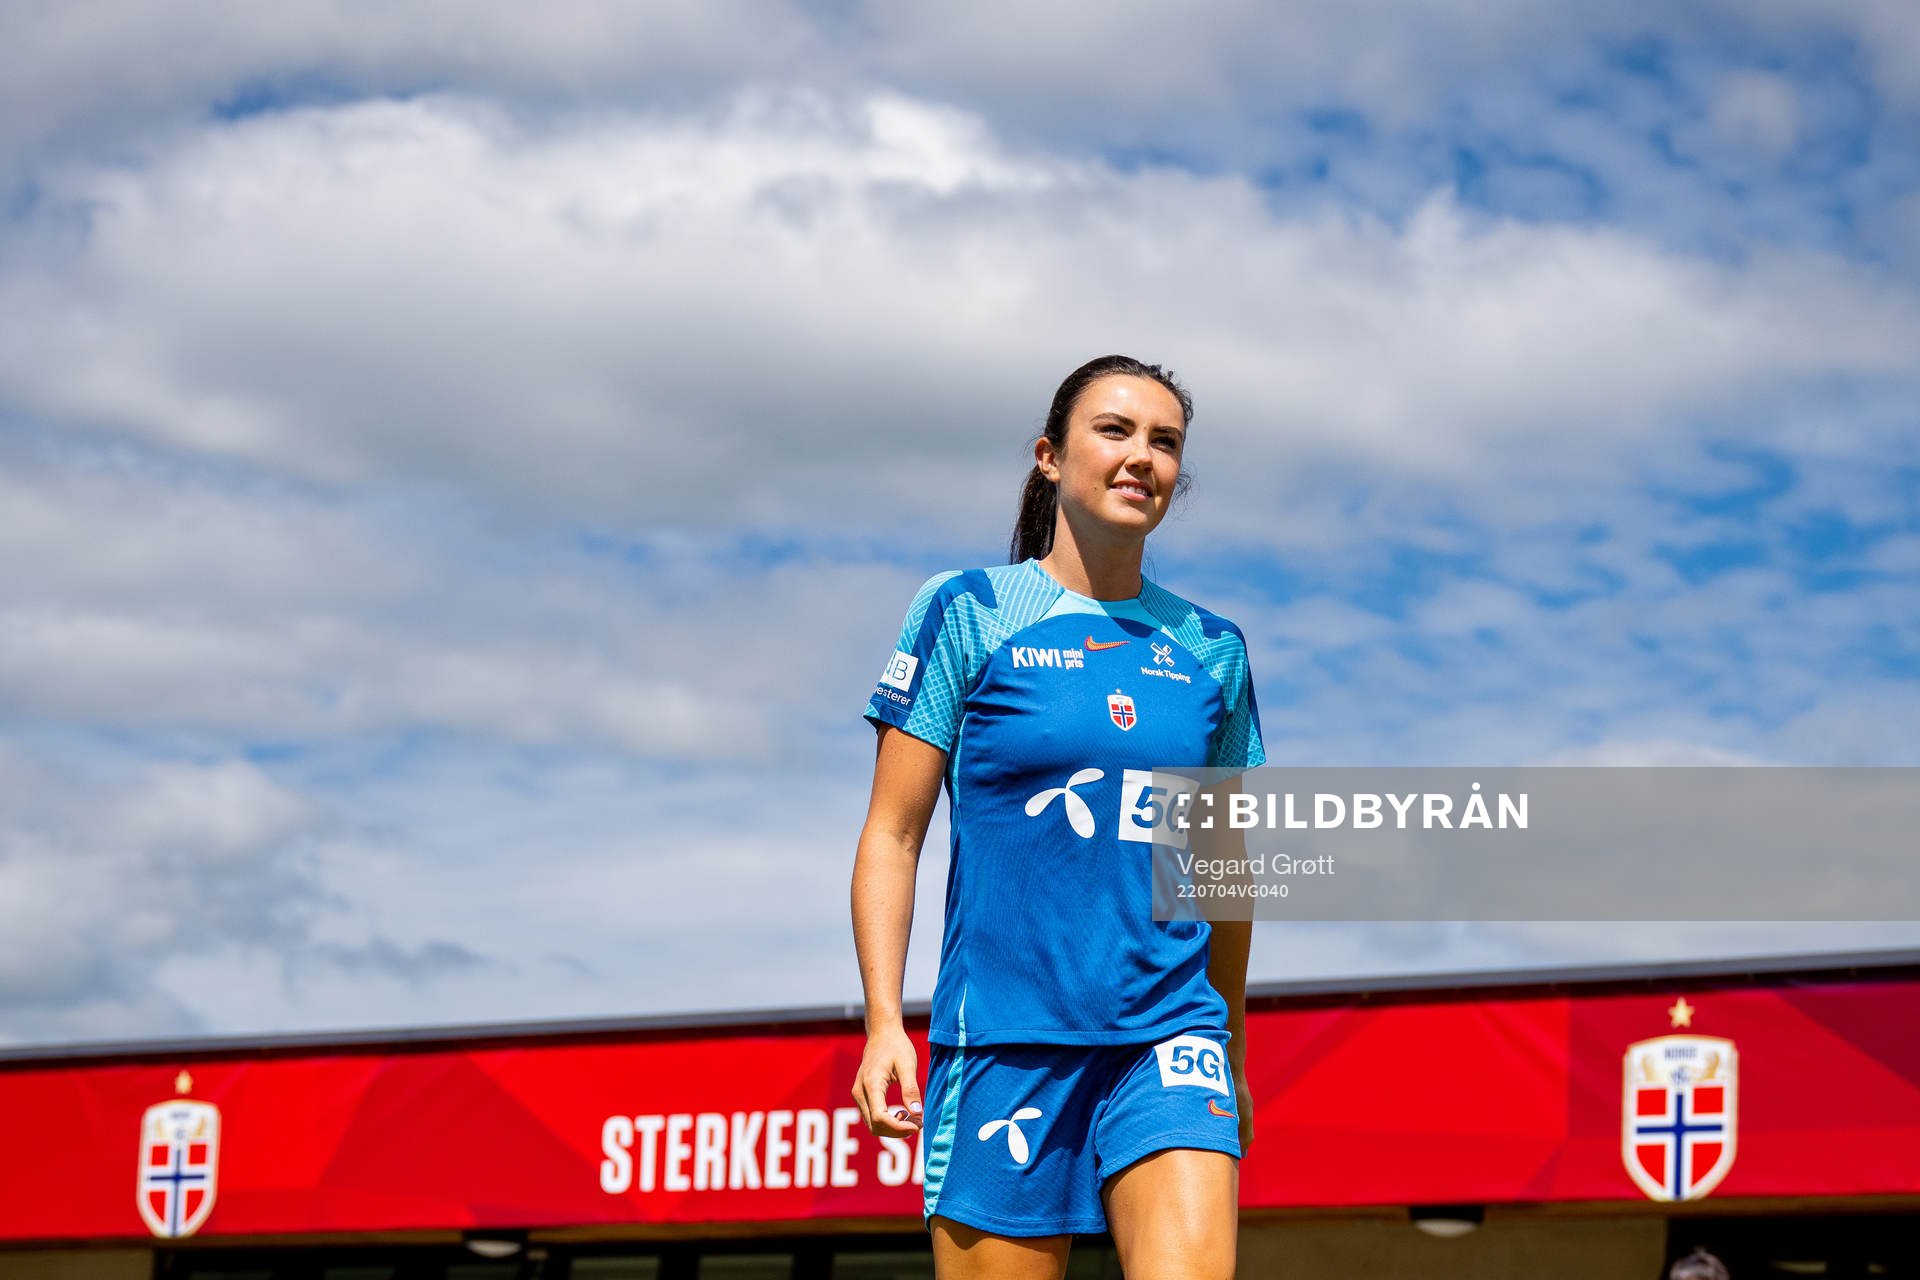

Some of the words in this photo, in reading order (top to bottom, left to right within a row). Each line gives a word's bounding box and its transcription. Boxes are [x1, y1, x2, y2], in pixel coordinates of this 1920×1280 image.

[1011, 646, 1062, 669] KIWI
[1062, 648, 1084, 659] mini
[1064, 659, 1084, 670] pris
[1140, 666, 1164, 677] Norsk
[1163, 669, 1192, 684] Tipping
[873, 685, 911, 706] esterer
[1169, 1045, 1221, 1081] 5G
[600, 1107, 860, 1194] STERKERE
